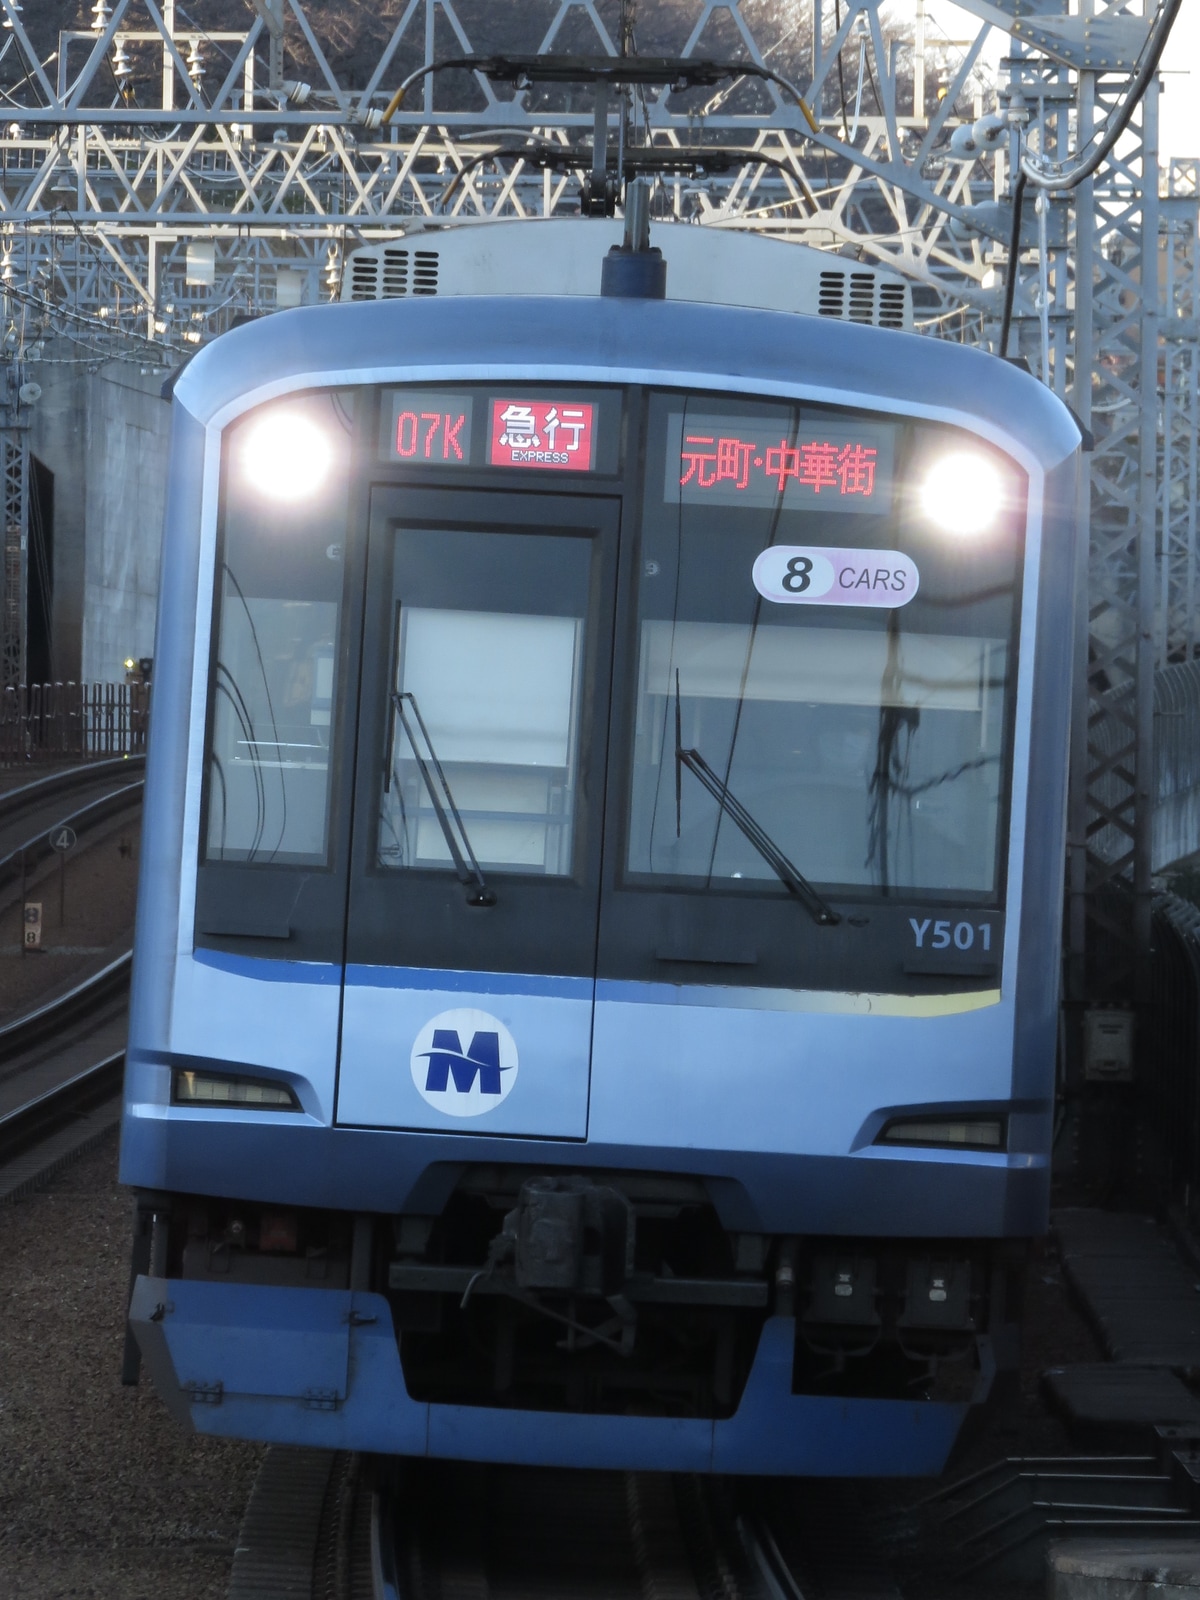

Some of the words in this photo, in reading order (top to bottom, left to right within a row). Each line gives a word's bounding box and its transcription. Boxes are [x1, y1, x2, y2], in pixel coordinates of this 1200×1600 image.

[396, 412, 465, 460] 07K
[499, 404, 586, 451] 急行
[511, 450, 570, 464] EXPRESS
[781, 556, 814, 593] 8
[838, 566, 907, 592] CARS
[56, 830, 70, 848] 4
[908, 917, 991, 951] Y501
